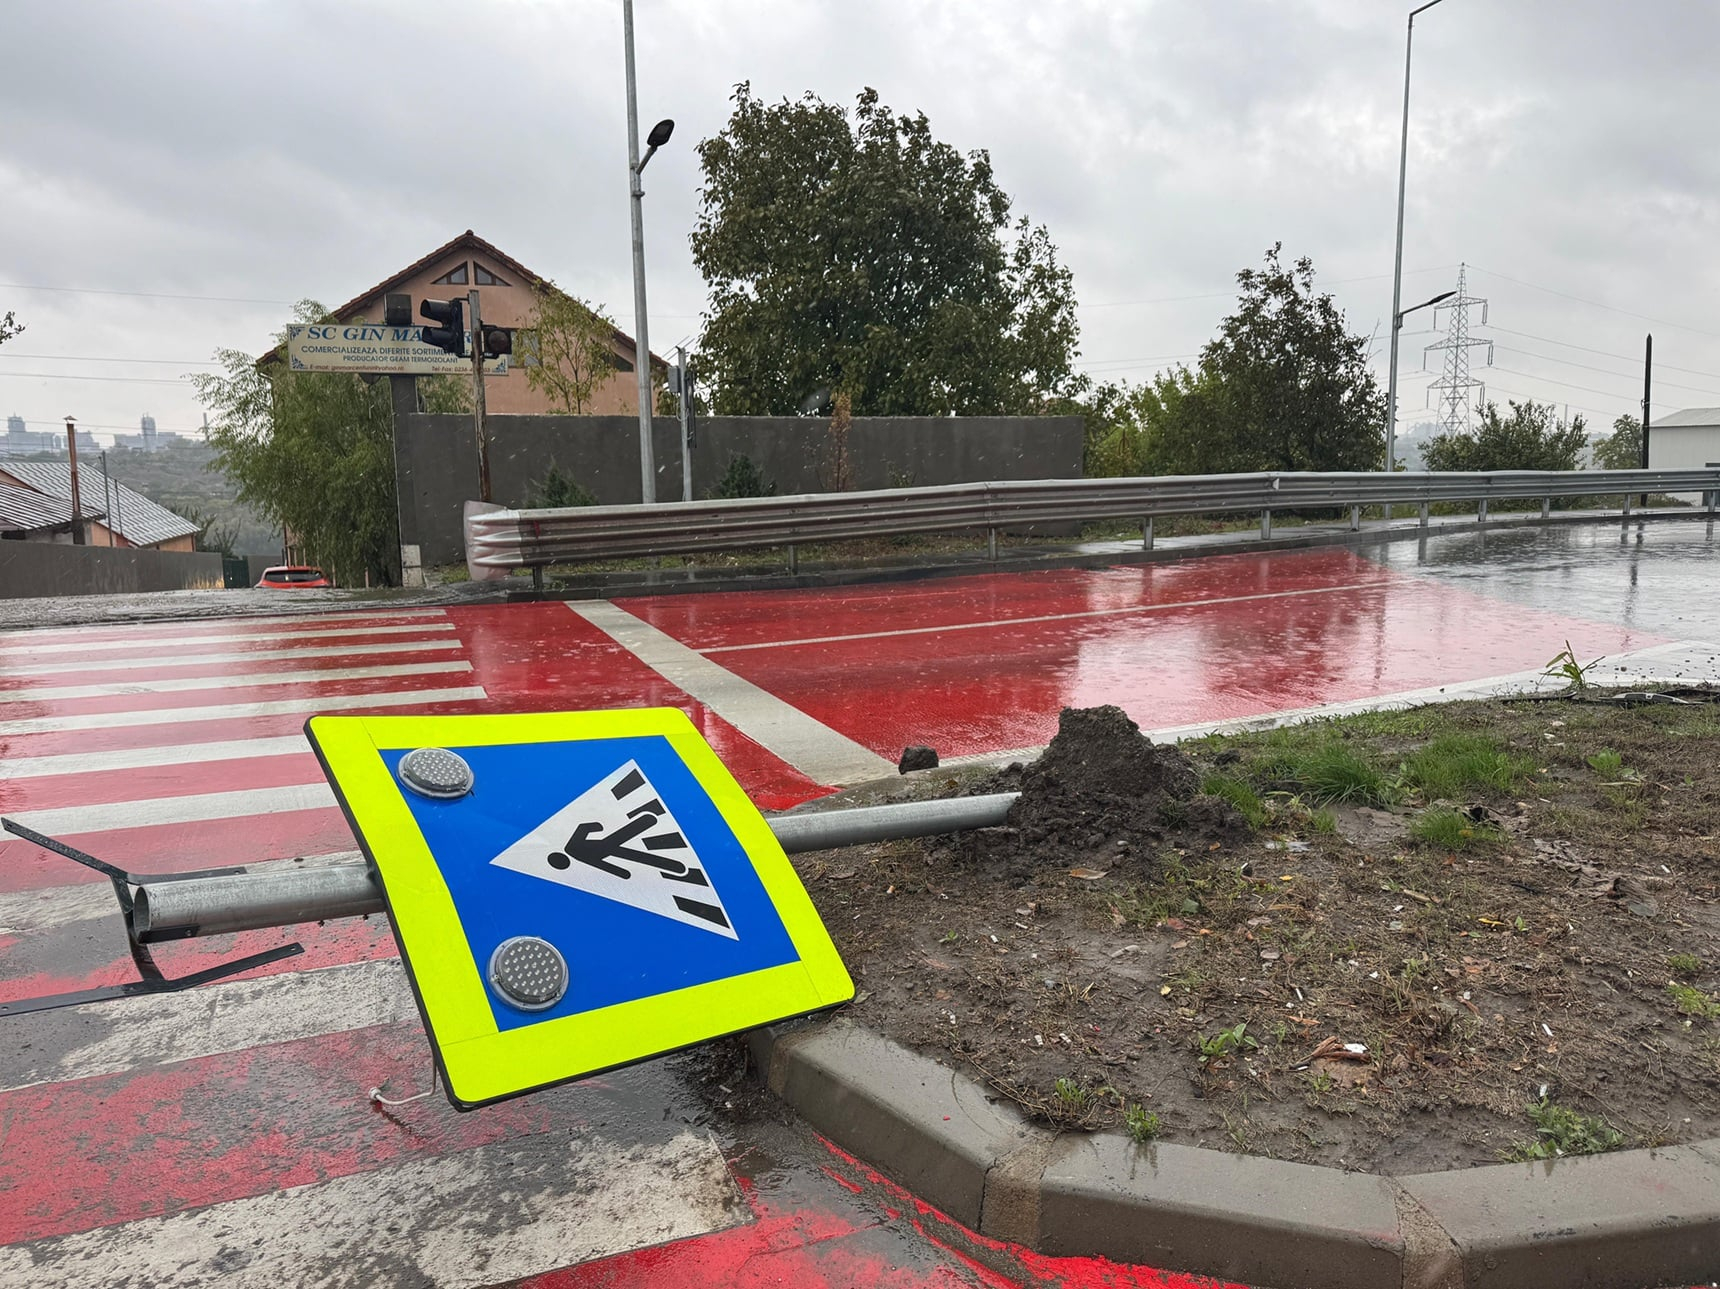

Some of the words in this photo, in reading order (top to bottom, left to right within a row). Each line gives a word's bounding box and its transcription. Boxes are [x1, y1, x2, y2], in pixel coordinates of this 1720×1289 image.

[307, 326, 337, 340] SC
[343, 327, 386, 341] GIN
[301, 345, 378, 354] COMERCIALIZEAZA
[379, 346, 411, 355] DIFERITE
